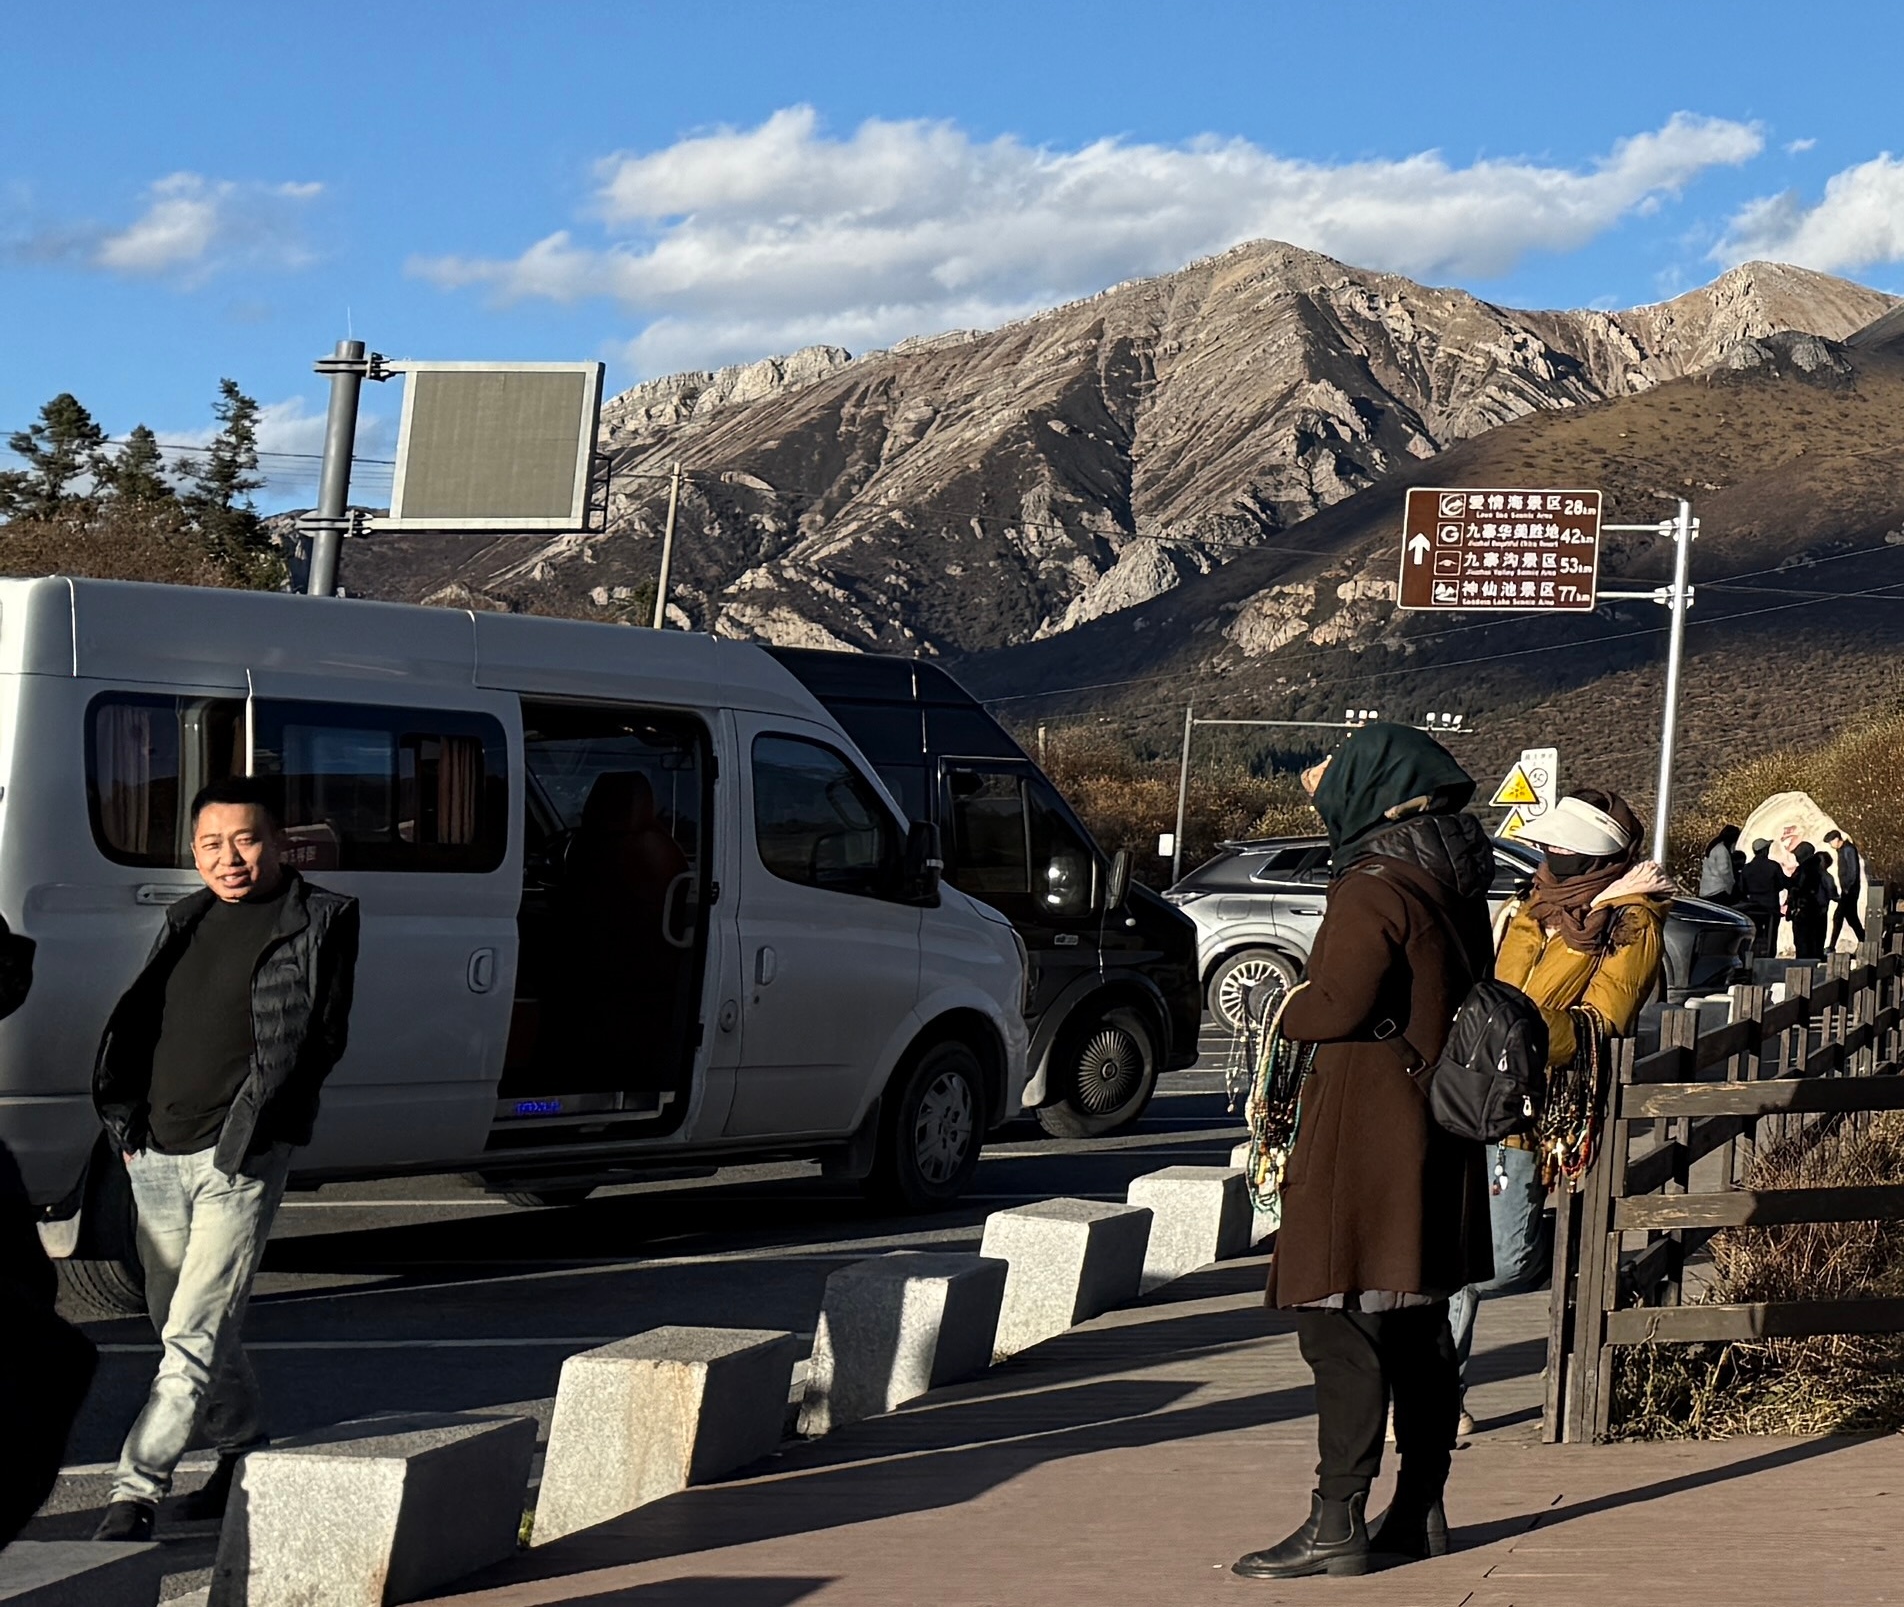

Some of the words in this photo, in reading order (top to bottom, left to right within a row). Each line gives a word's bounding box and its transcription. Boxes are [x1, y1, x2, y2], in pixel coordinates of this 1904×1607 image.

[1468, 495, 1562, 511] 爱情海景区
[1463, 552, 1557, 568] 九寨沟景区
[1461, 580, 1555, 597] 神仙池景区
[1558, 585, 1591, 602] 77km
